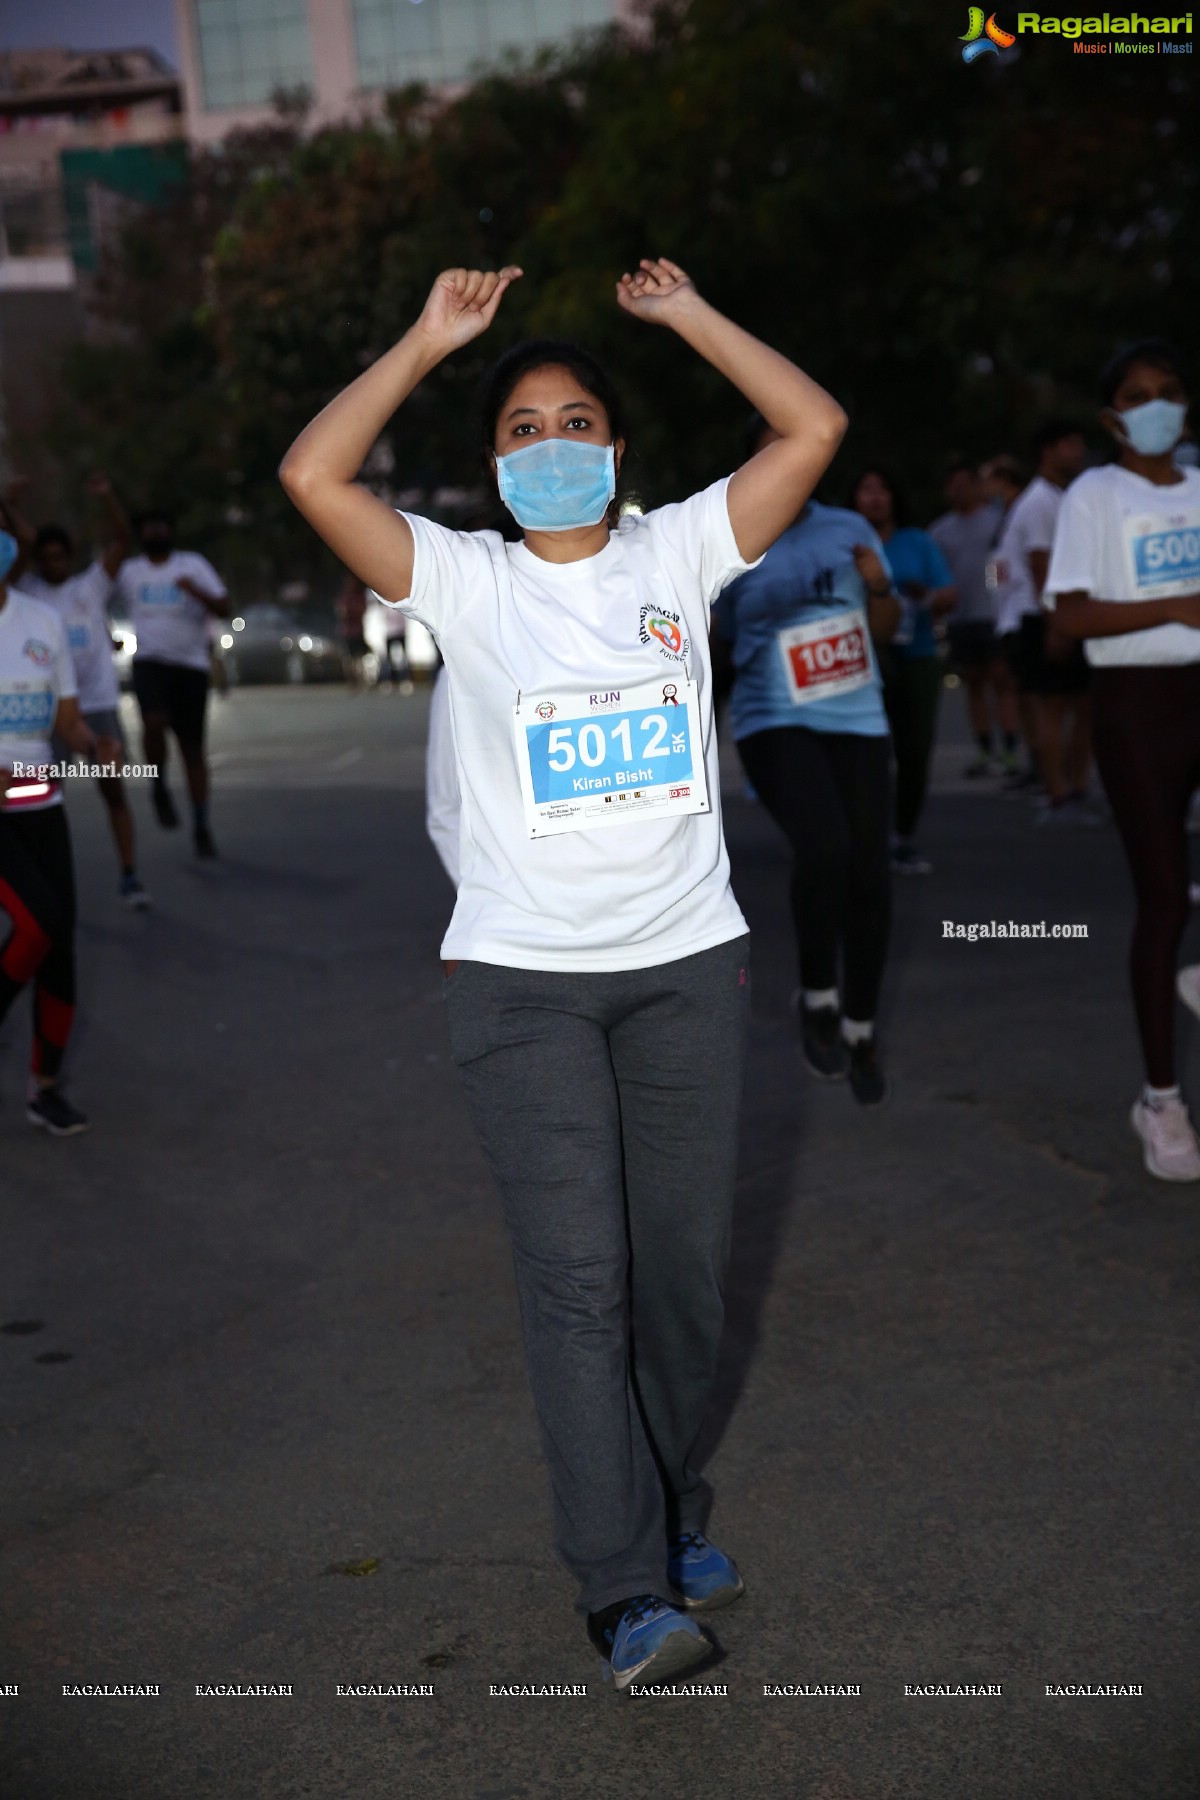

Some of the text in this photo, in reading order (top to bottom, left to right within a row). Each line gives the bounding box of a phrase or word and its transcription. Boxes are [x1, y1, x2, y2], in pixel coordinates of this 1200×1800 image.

[800, 634, 861, 673] 1042
[589, 691, 621, 705] RUN
[547, 714, 671, 773] 5012
[671, 730, 686, 753] 5K
[573, 767, 654, 792] Kiran Bisht
